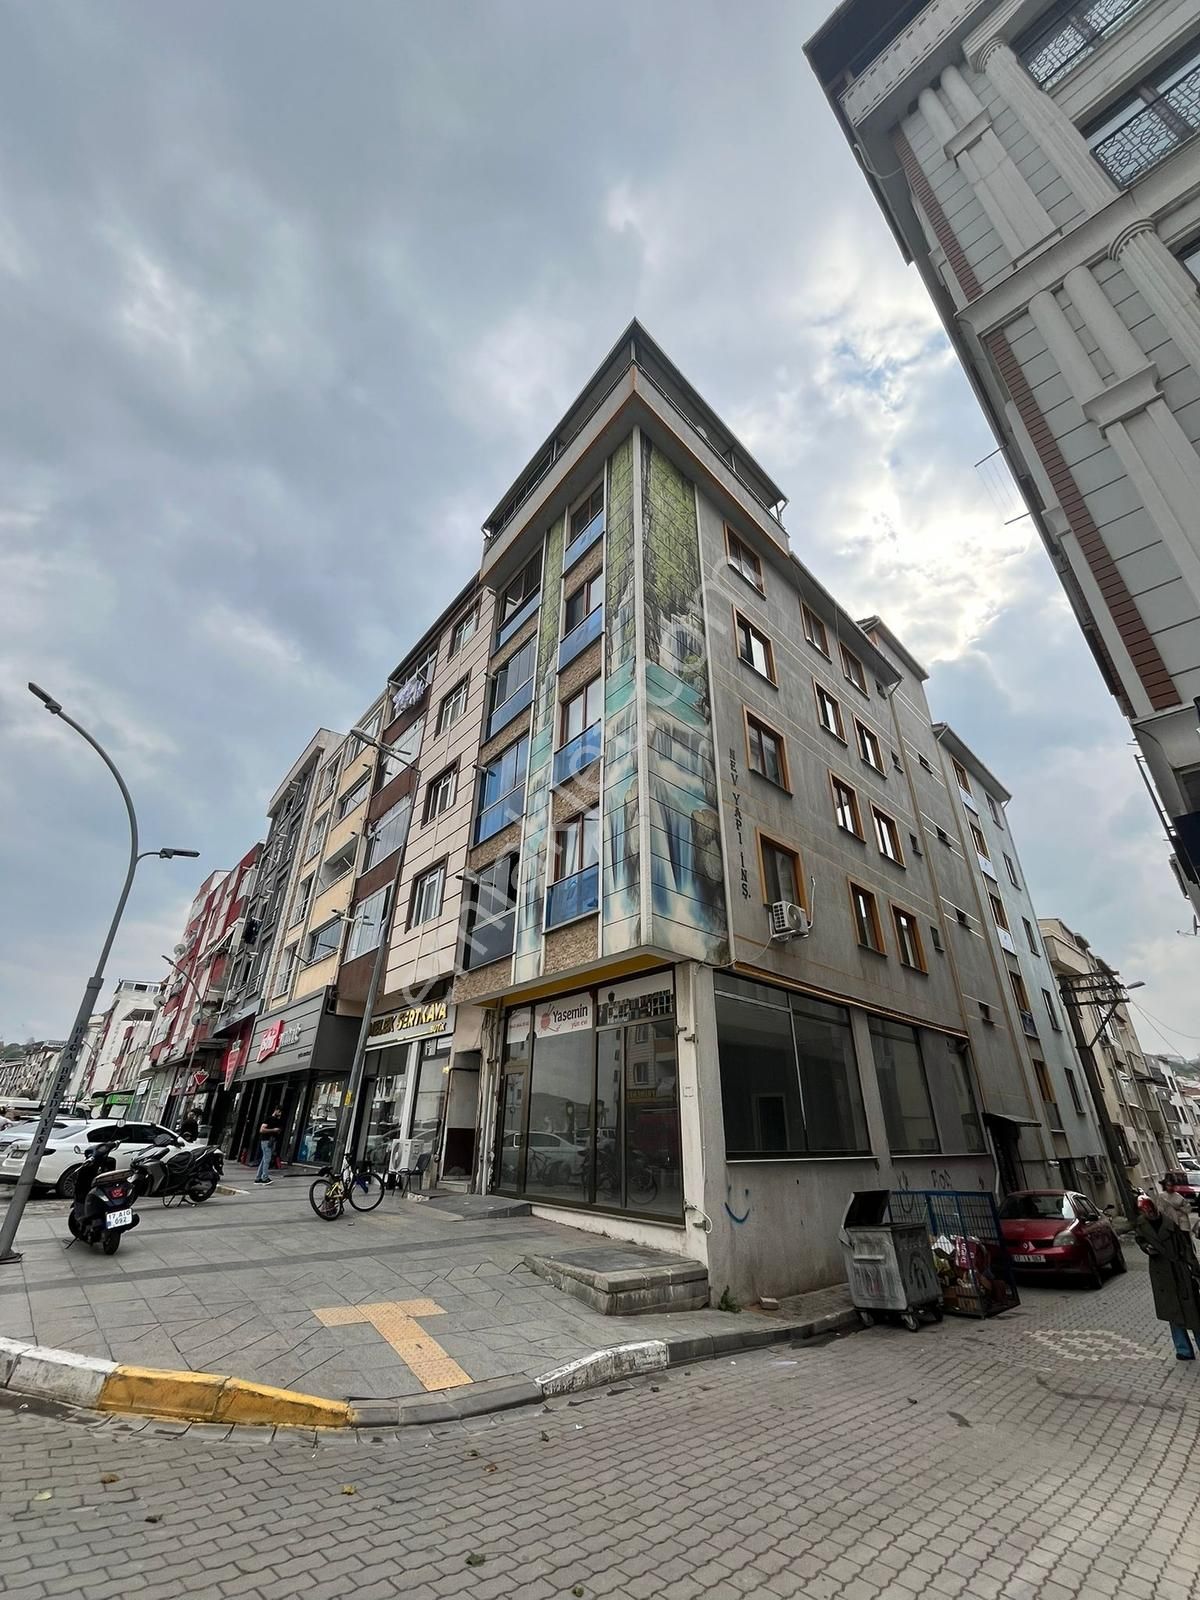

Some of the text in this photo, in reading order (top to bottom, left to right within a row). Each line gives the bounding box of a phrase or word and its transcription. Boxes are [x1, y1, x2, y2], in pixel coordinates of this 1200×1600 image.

[732, 792, 743, 845] YAPI
[396, 1002, 447, 1030] SERTKAYA
[553, 1004, 588, 1023] Yasemin
